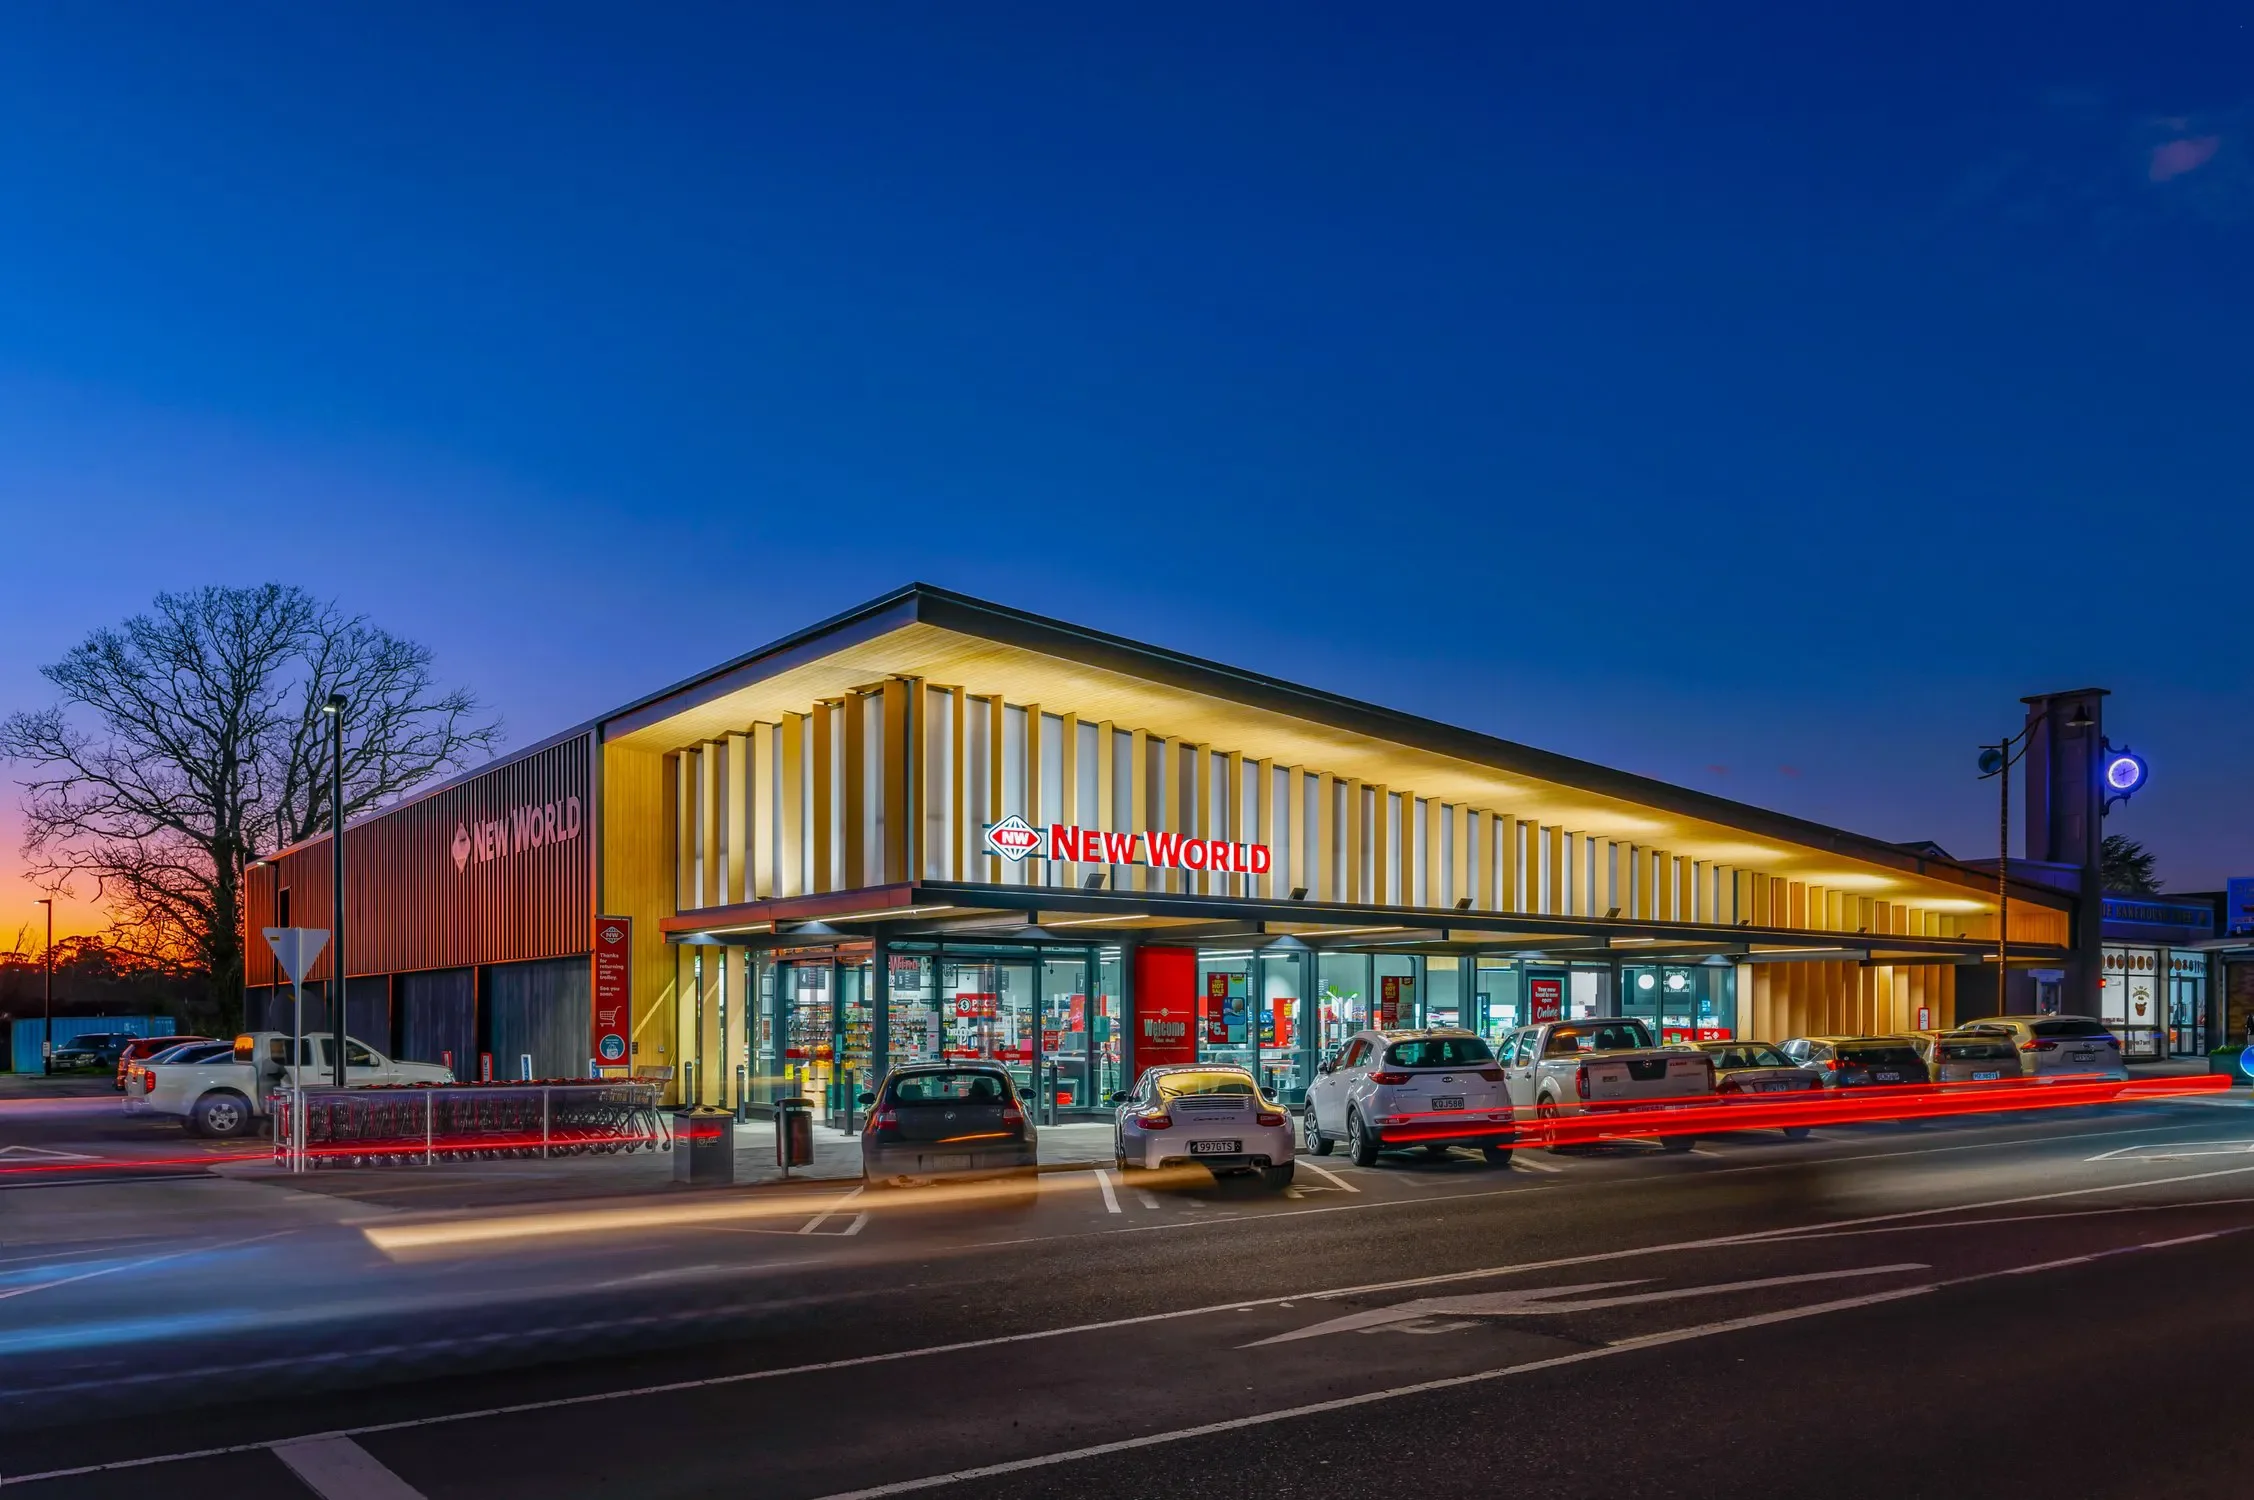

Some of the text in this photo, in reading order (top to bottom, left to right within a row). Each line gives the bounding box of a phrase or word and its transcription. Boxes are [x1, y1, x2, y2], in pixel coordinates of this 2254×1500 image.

[474, 796, 580, 864] NEW WORLD
[1000, 831, 1030, 845] NW
[1048, 823, 1271, 874] NEW WORLD
[972, 999, 996, 1007] PRICE
[1537, 1005, 1558, 1019] Online
[1144, 1018, 1185, 1036] Welcome
[1200, 1142, 1233, 1151] 997GTS
